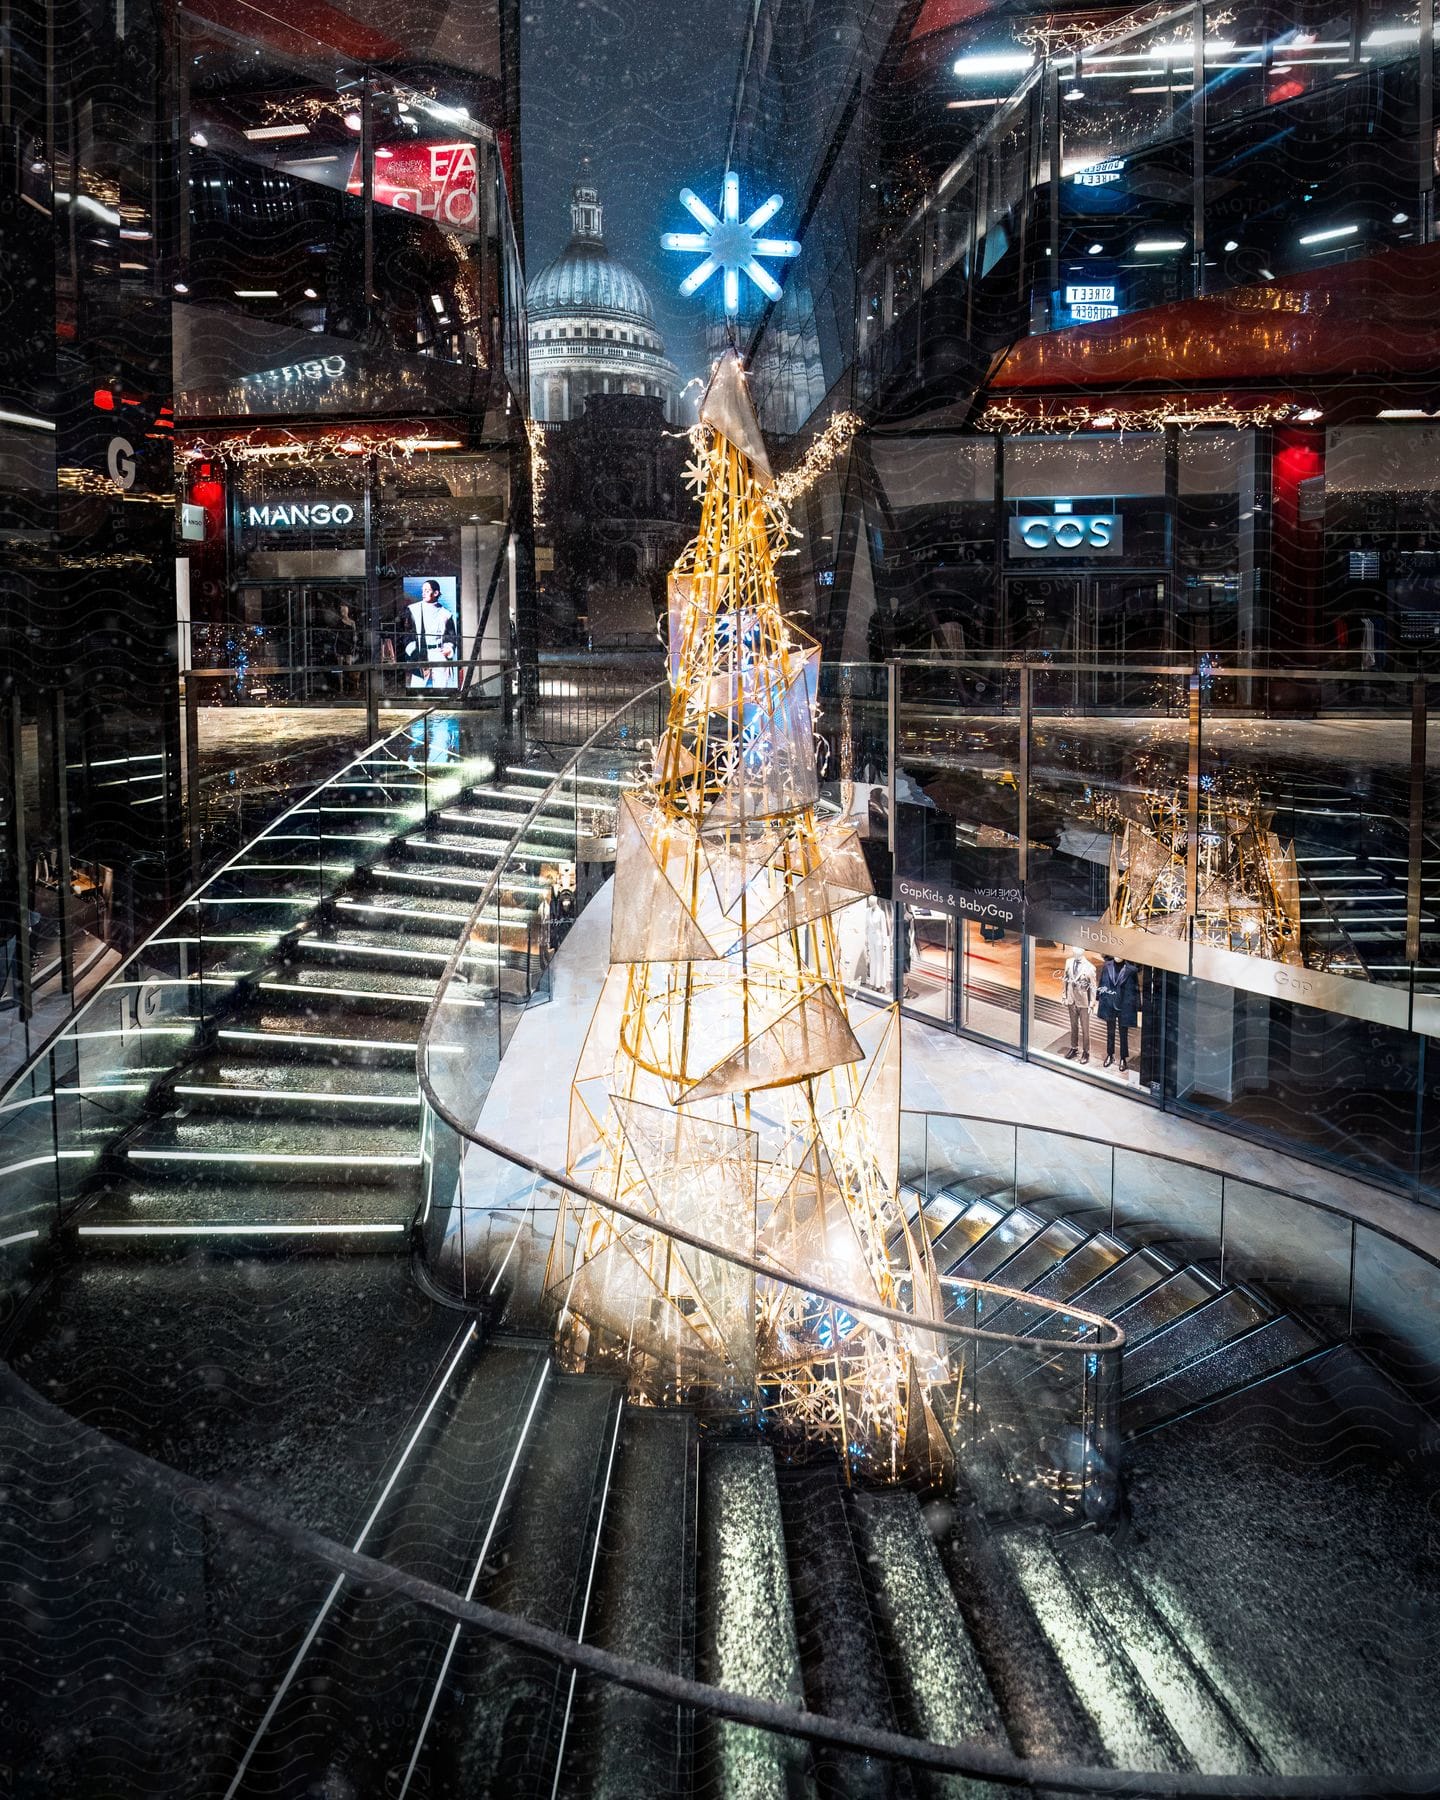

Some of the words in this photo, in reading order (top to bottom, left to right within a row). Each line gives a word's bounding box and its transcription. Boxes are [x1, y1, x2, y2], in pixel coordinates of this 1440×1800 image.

[106, 436, 136, 490] G
[249, 504, 354, 526] MANGO
[1022, 518, 1112, 550] COS
[899, 882, 944, 904] GapKids
[946, 894, 956, 906] &
[959, 896, 1014, 923] BabyGap
[1079, 925, 1128, 946] Hobbs
[1273, 970, 1313, 994] Gap
